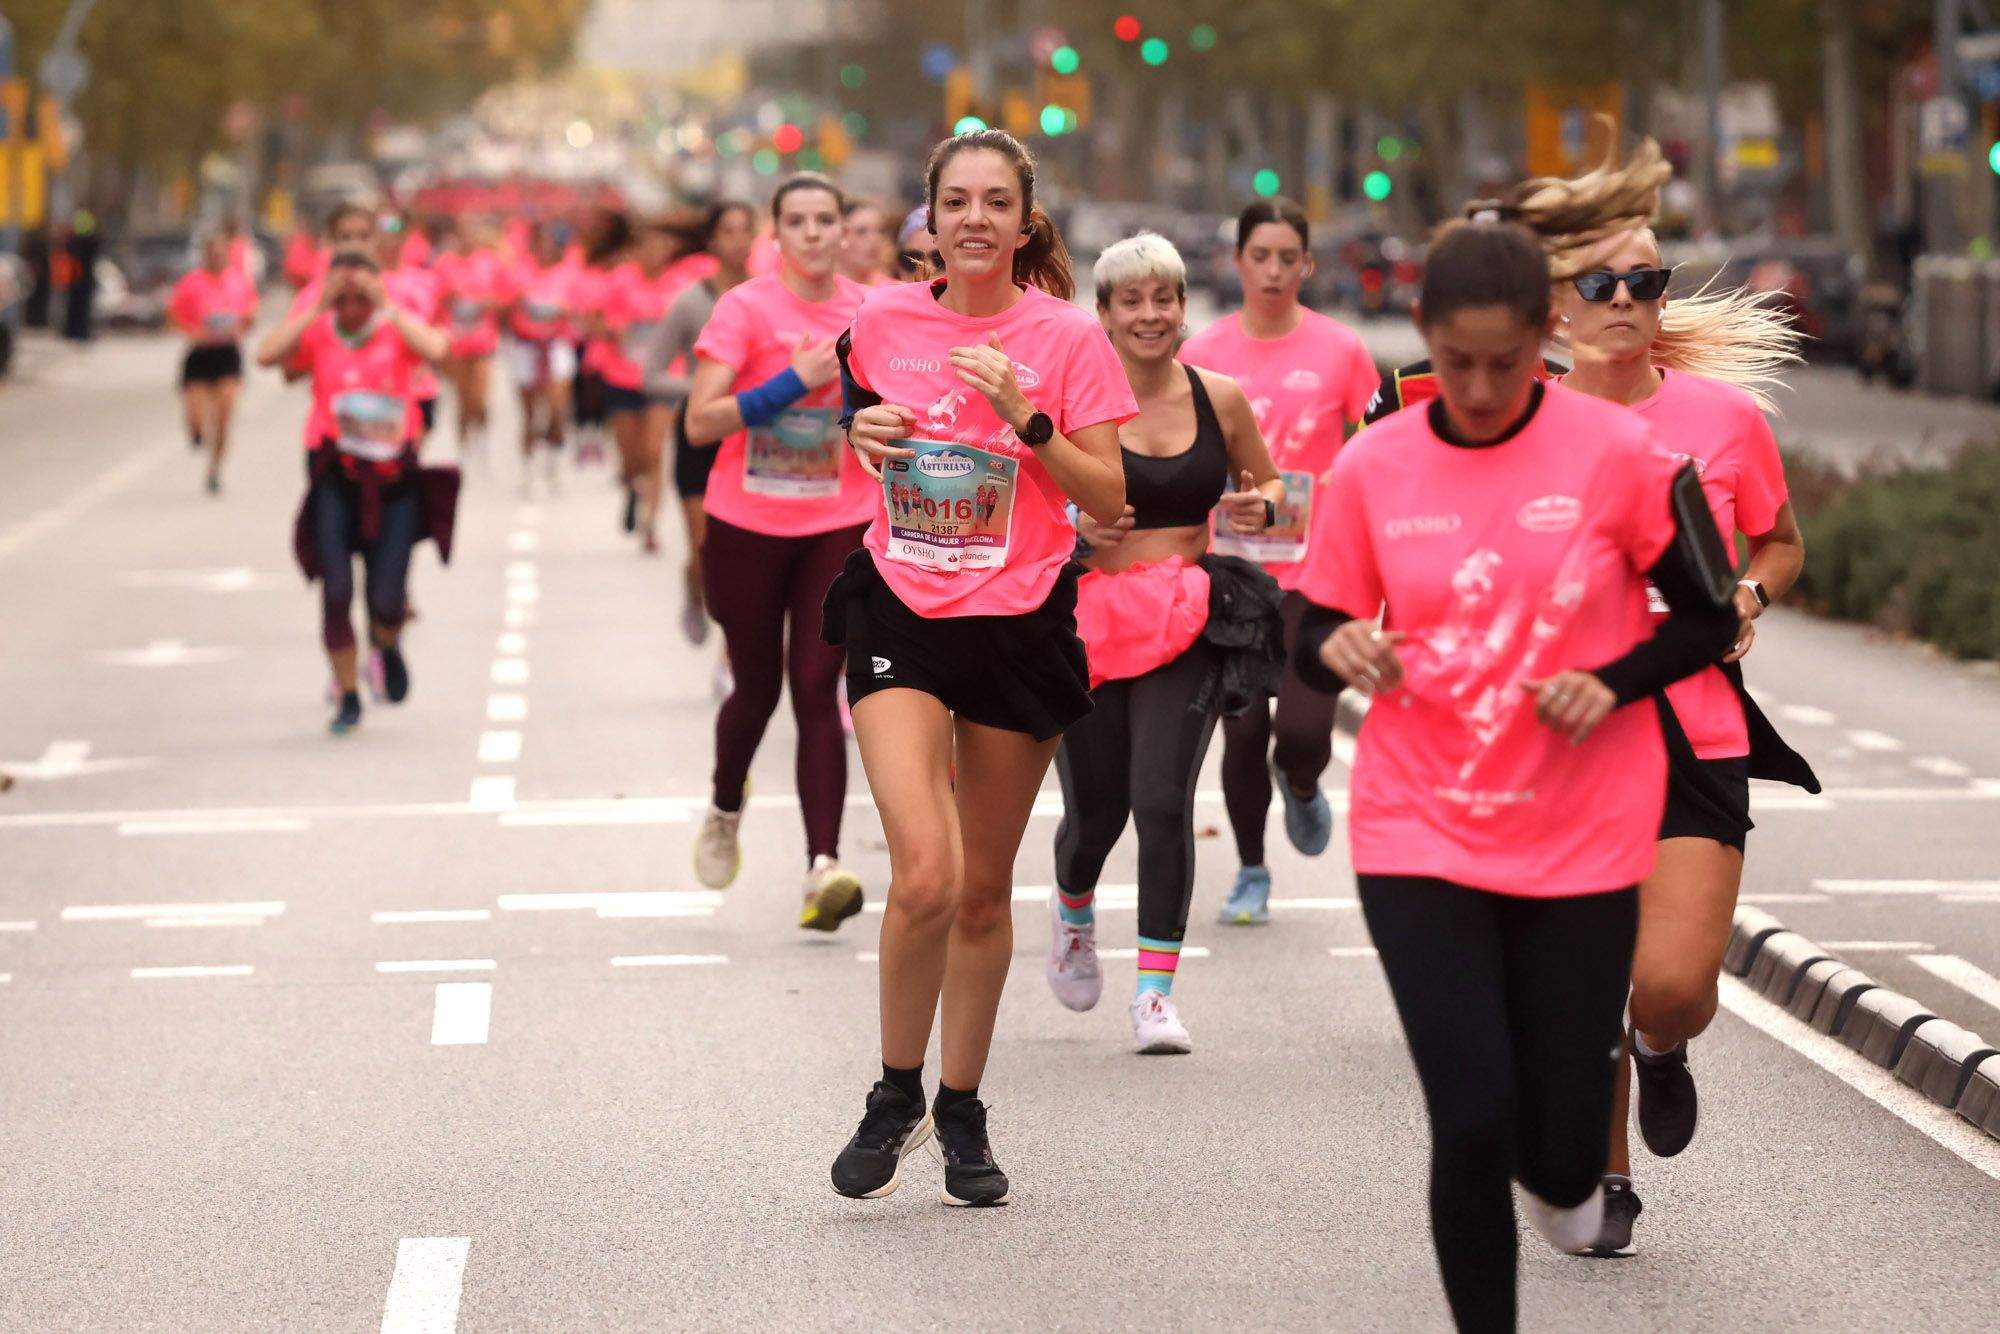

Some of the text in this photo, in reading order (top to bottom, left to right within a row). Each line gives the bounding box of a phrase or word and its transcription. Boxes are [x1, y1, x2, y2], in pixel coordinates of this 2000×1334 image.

[889, 357, 941, 373] OYSHO
[919, 460, 972, 471] ASTURIANA
[923, 498, 972, 519] 016
[901, 530, 924, 540] CARRERA
[925, 534, 932, 542] DE
[932, 535, 938, 543] LA
[938, 537, 960, 545] MUJER
[931, 525, 959, 535] 21387
[903, 544, 935, 560] OYSHO
